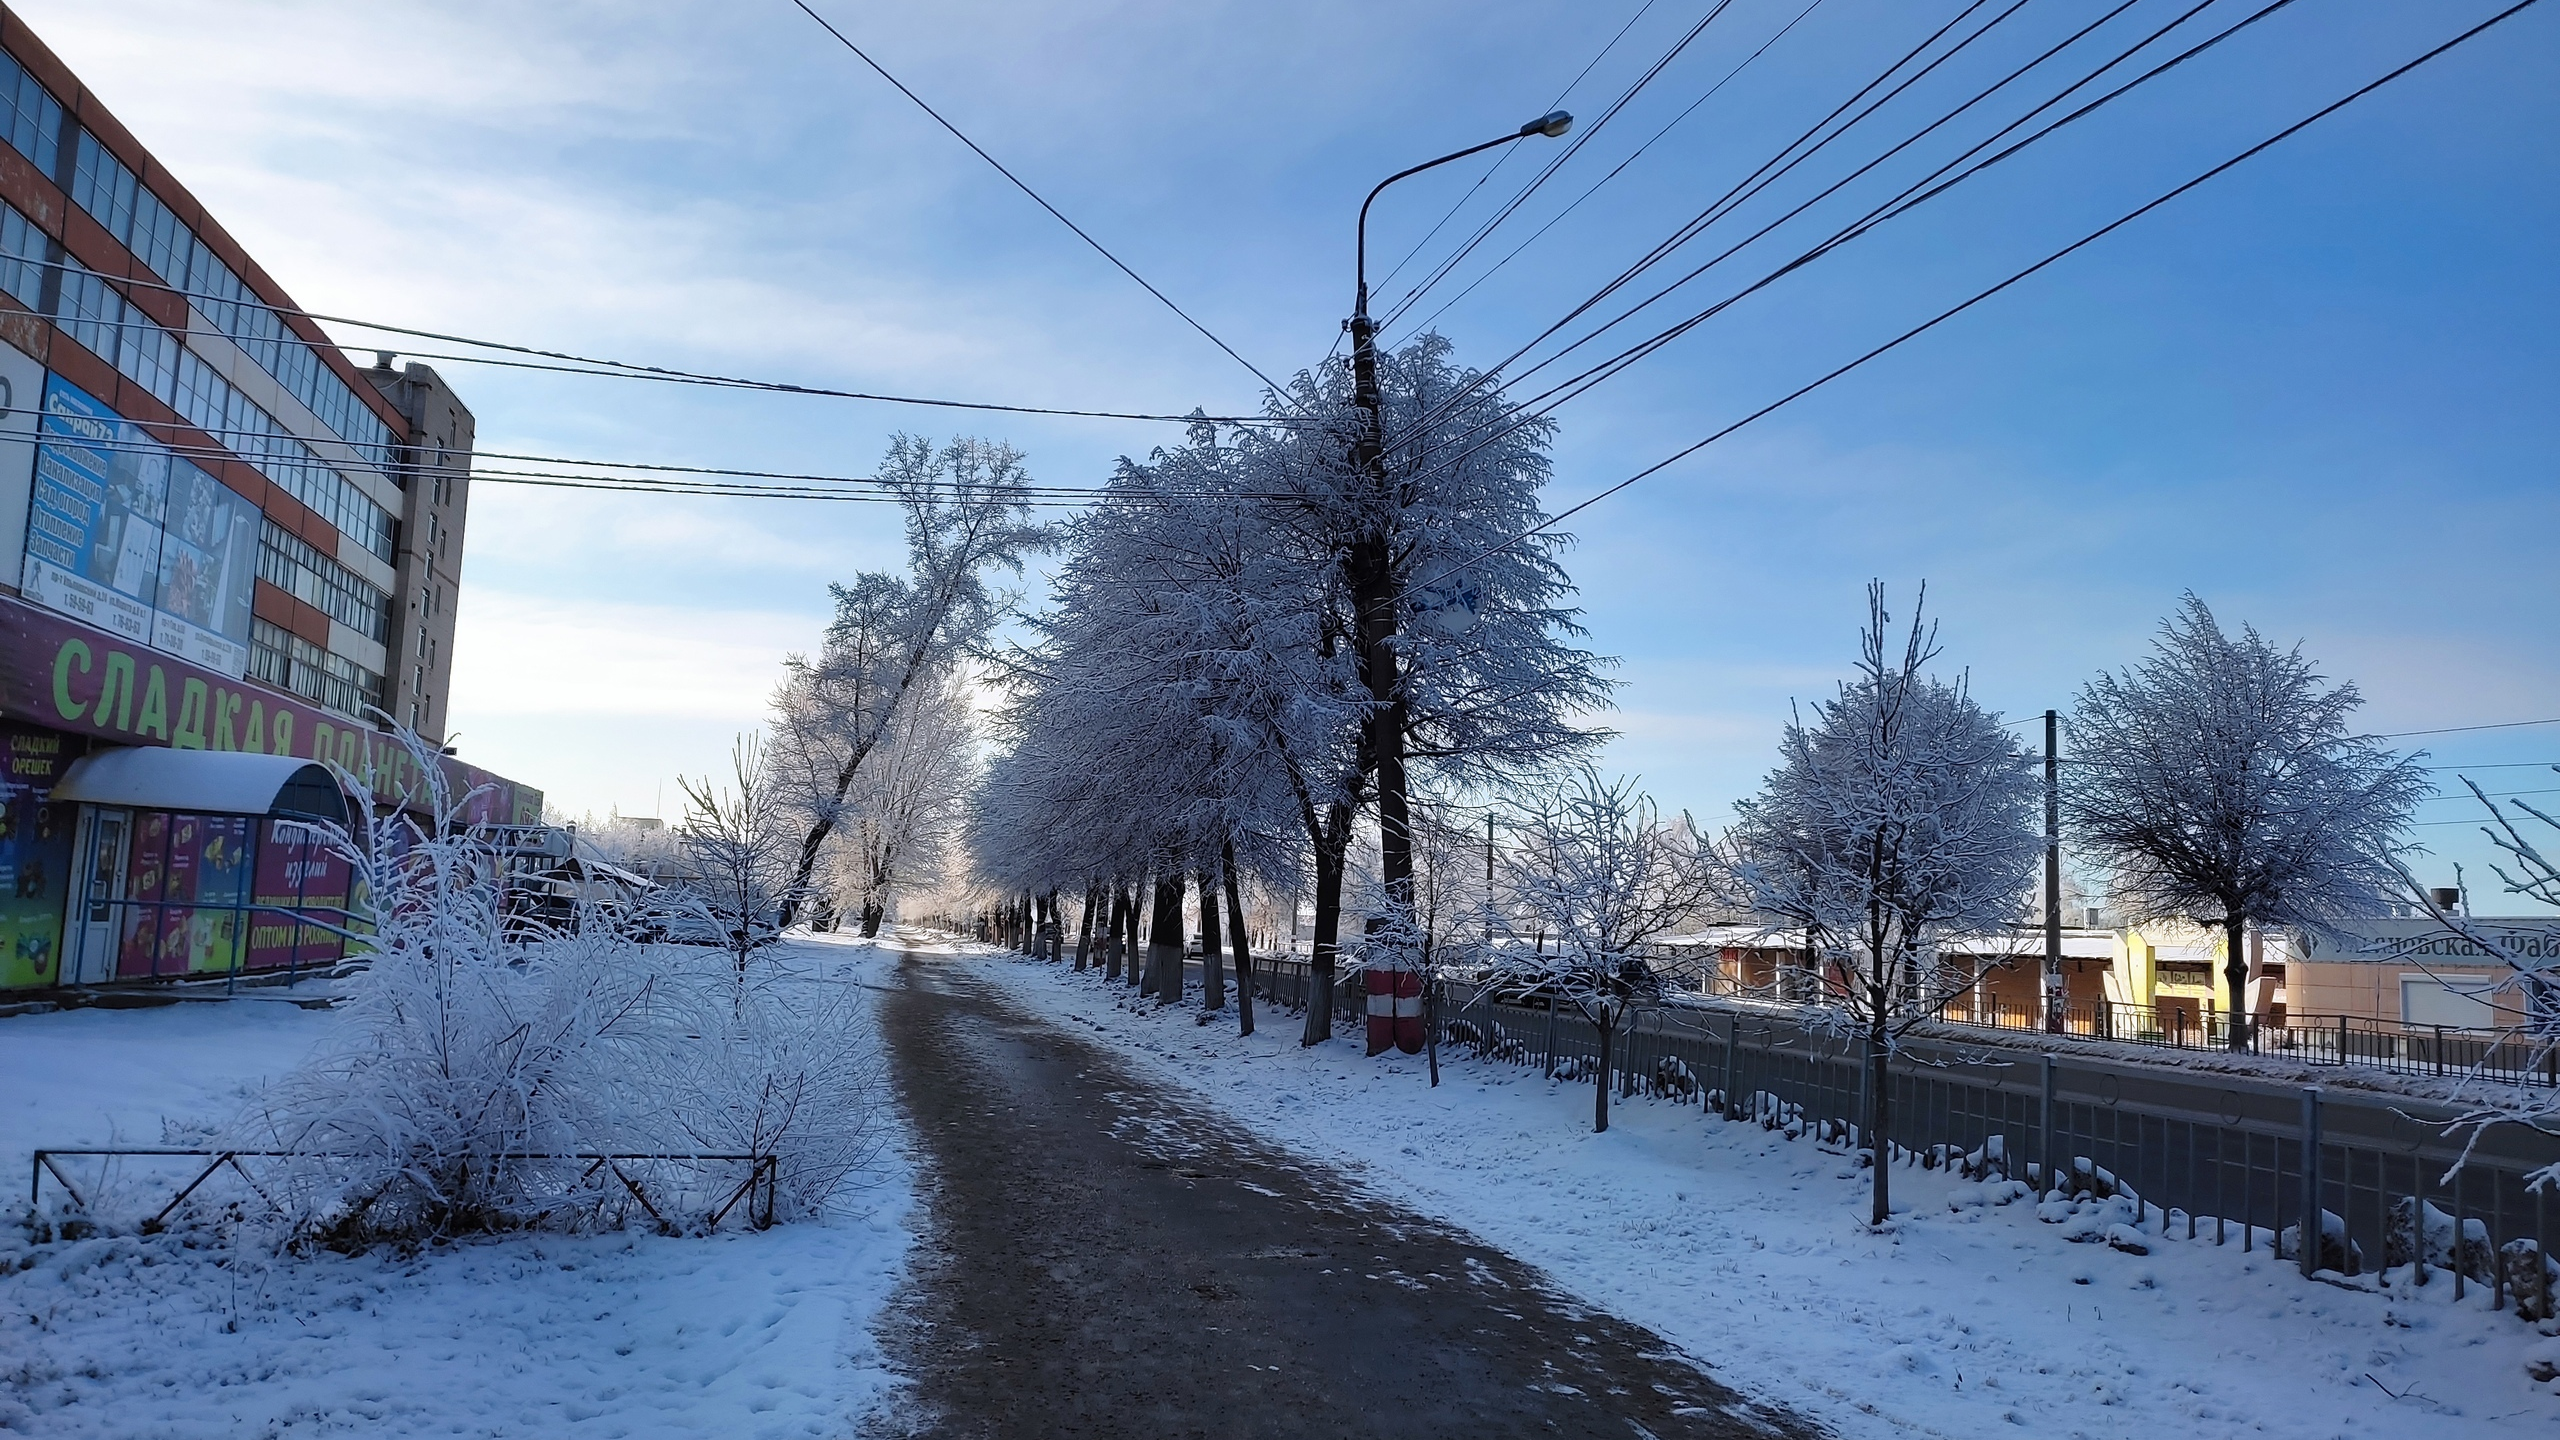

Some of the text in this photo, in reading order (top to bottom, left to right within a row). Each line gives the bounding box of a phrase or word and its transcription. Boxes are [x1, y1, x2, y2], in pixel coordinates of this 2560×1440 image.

[40, 452, 104, 503] Канализация
[33, 505, 84, 548] Отопление
[58, 491, 91, 527] огород
[29, 530, 75, 569] Запчасти
[53, 638, 294, 757] СЛАДКАЯ
[11, 733, 60, 755] СЛАДКИЙ
[12, 757, 53, 775] ОРЕШЕК
[252, 925, 287, 950] ОПТОМ
